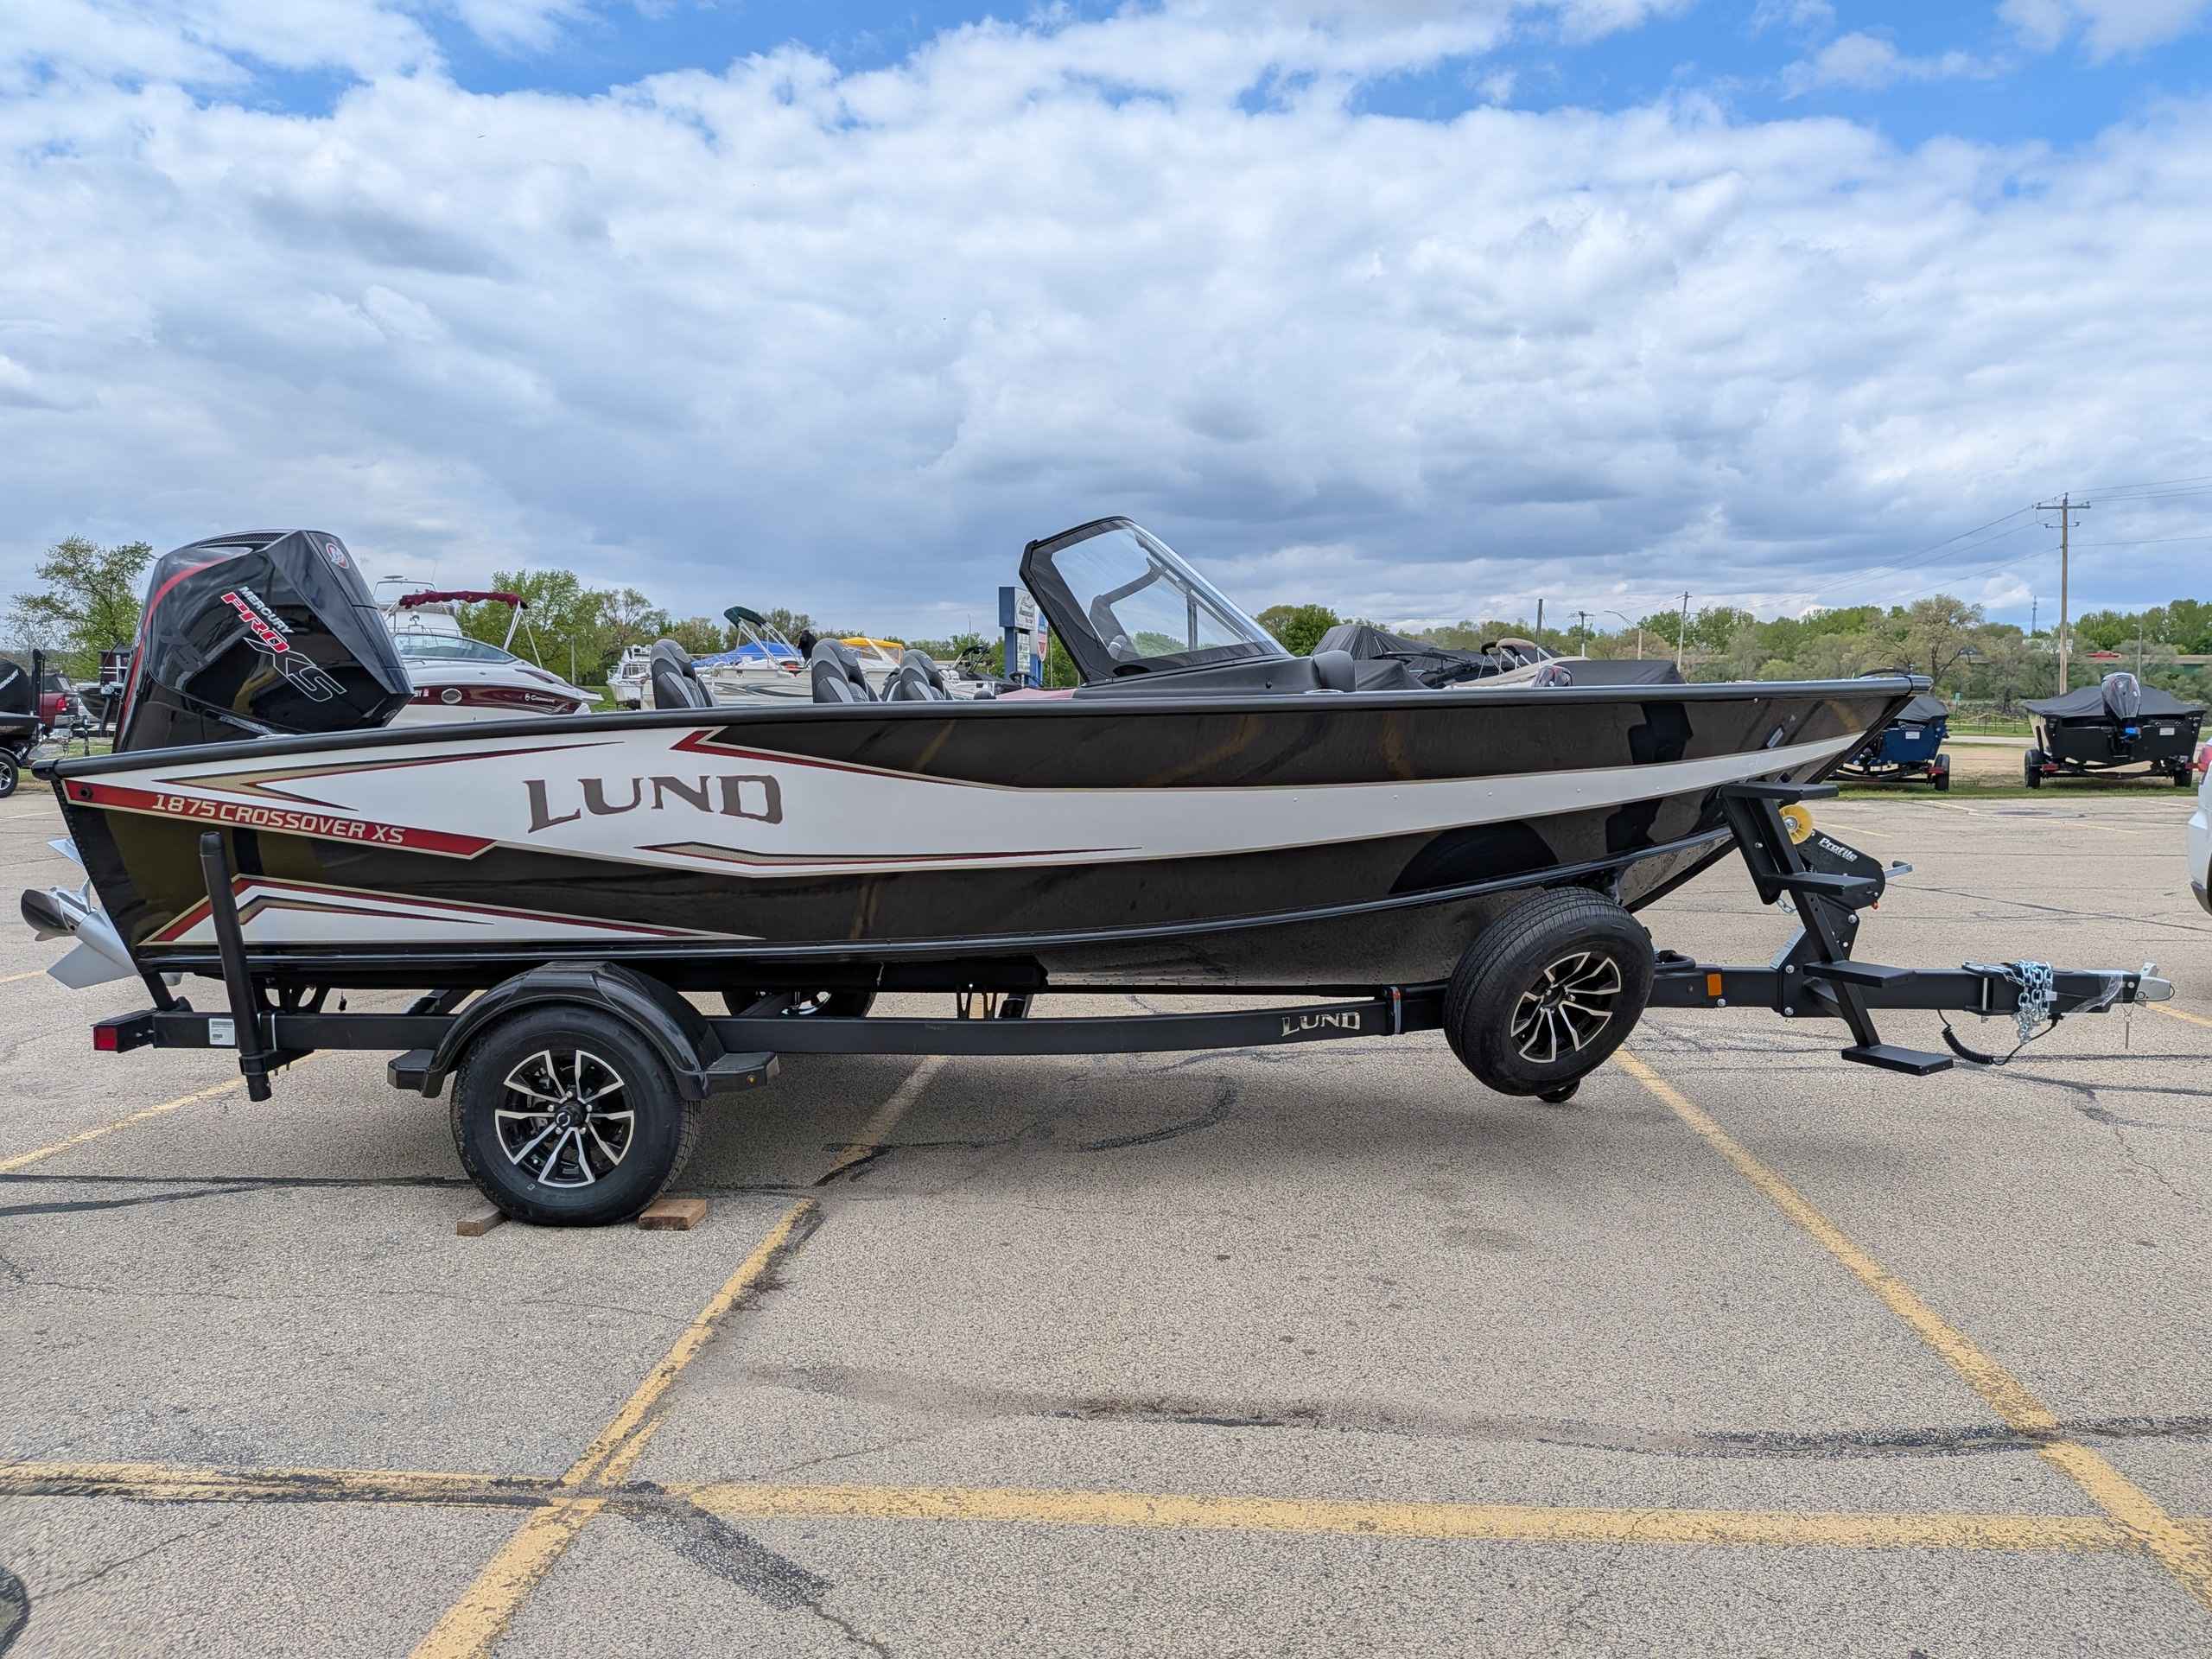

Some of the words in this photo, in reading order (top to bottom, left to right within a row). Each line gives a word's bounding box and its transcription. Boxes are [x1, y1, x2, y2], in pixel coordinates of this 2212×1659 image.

[220, 591, 290, 653] PRO
[238, 586, 295, 633] MERCURY
[242, 627, 347, 702] XS
[152, 794, 218, 817] 1875
[219, 804, 366, 838] CROSSOVER
[372, 823, 407, 844] XS
[523, 775, 783, 834] LUND
[1817, 837, 1859, 862] Profile
[1281, 1011, 1361, 1037] LUND
